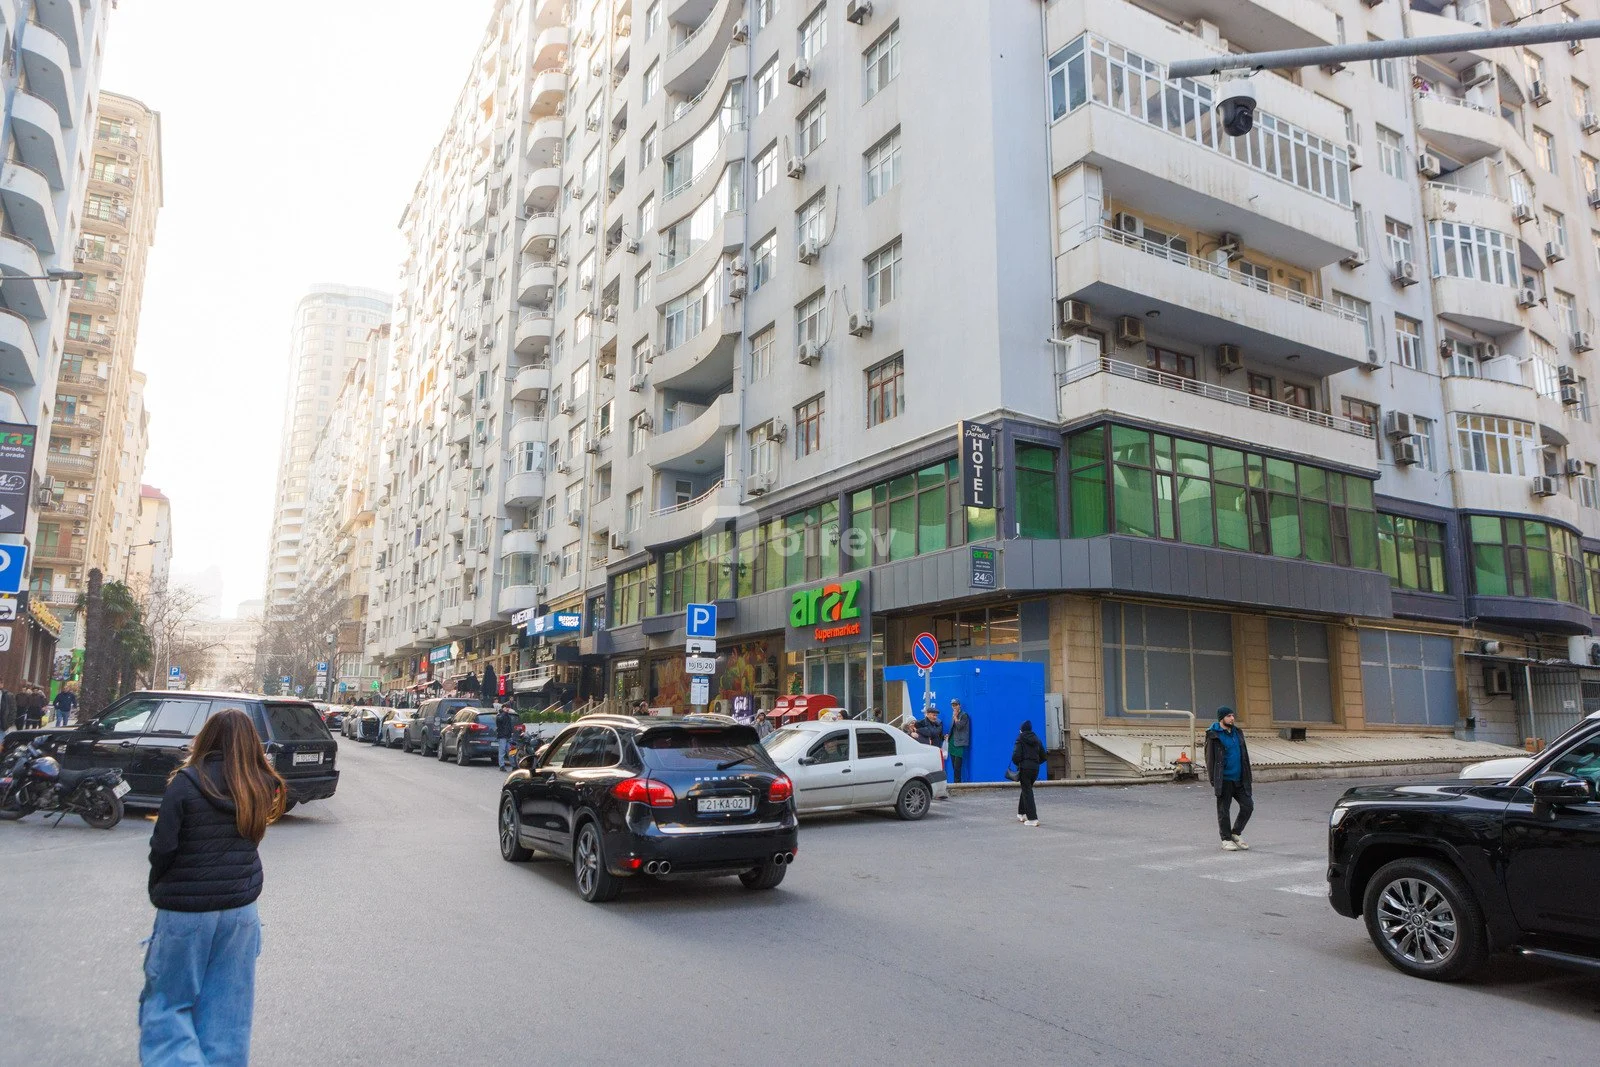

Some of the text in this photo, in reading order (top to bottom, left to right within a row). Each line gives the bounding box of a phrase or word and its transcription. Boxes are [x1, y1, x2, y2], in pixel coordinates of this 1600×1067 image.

[972, 438, 984, 505] HOTEL
[973, 551, 993, 560] araz
[790, 580, 861, 628] araz
[693, 607, 710, 633] P
[815, 623, 860, 642] Supermarket
[171, 667, 179, 675] P
[923, 691, 936, 699] AM
[706, 799, 748, 809] 21-KA-021
